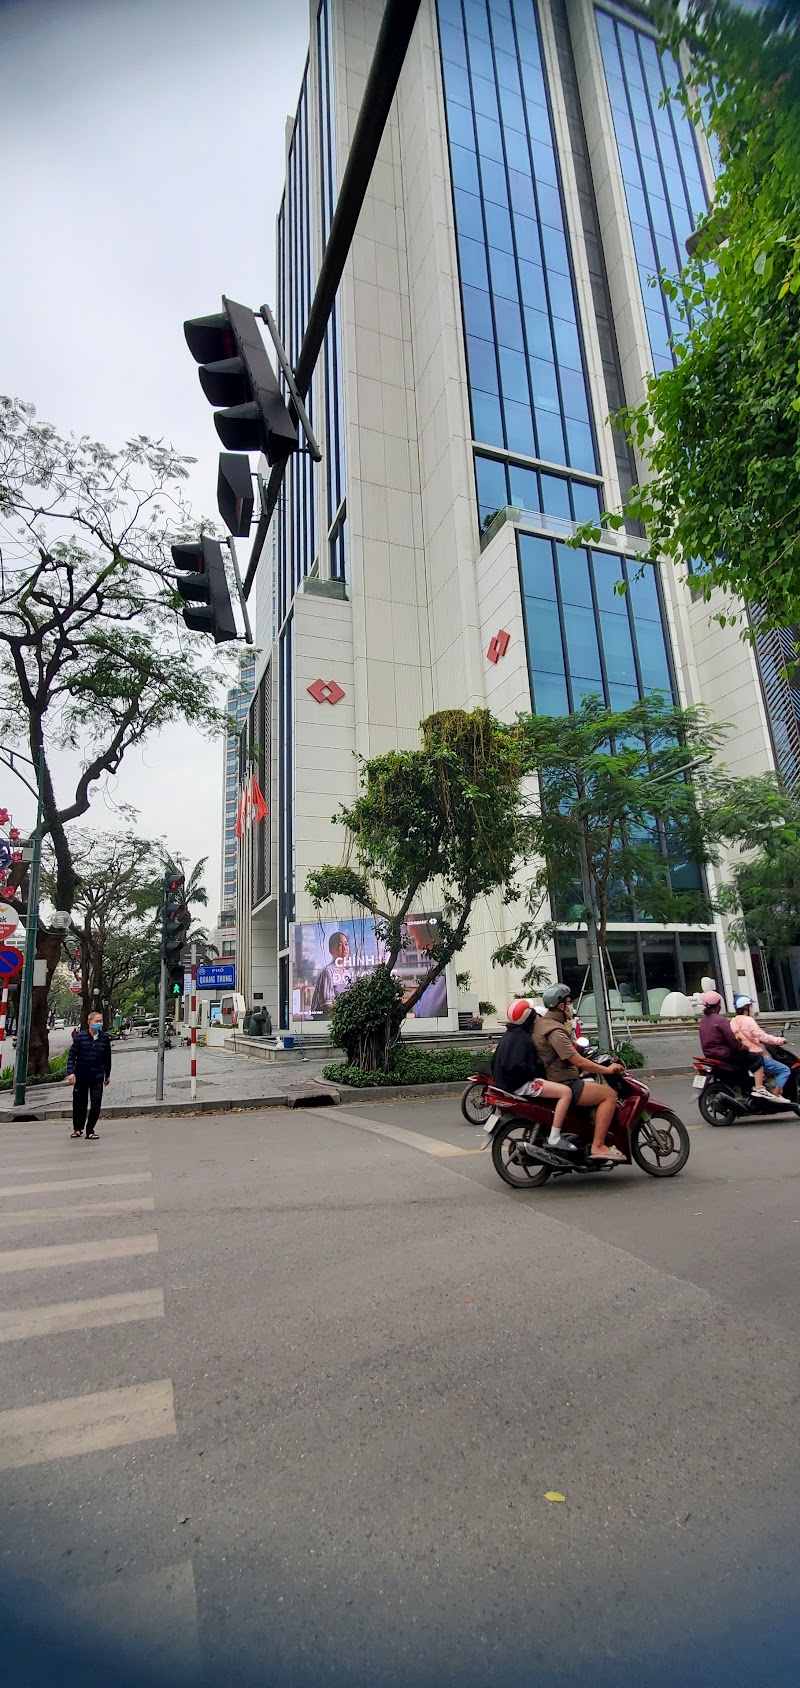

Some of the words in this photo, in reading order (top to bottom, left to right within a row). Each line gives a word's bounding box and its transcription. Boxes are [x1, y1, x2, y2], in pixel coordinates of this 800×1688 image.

[335, 954, 375, 967] CHÍNH
[199, 976, 216, 984] QUANG
[216, 975, 233, 983] TRUNG
